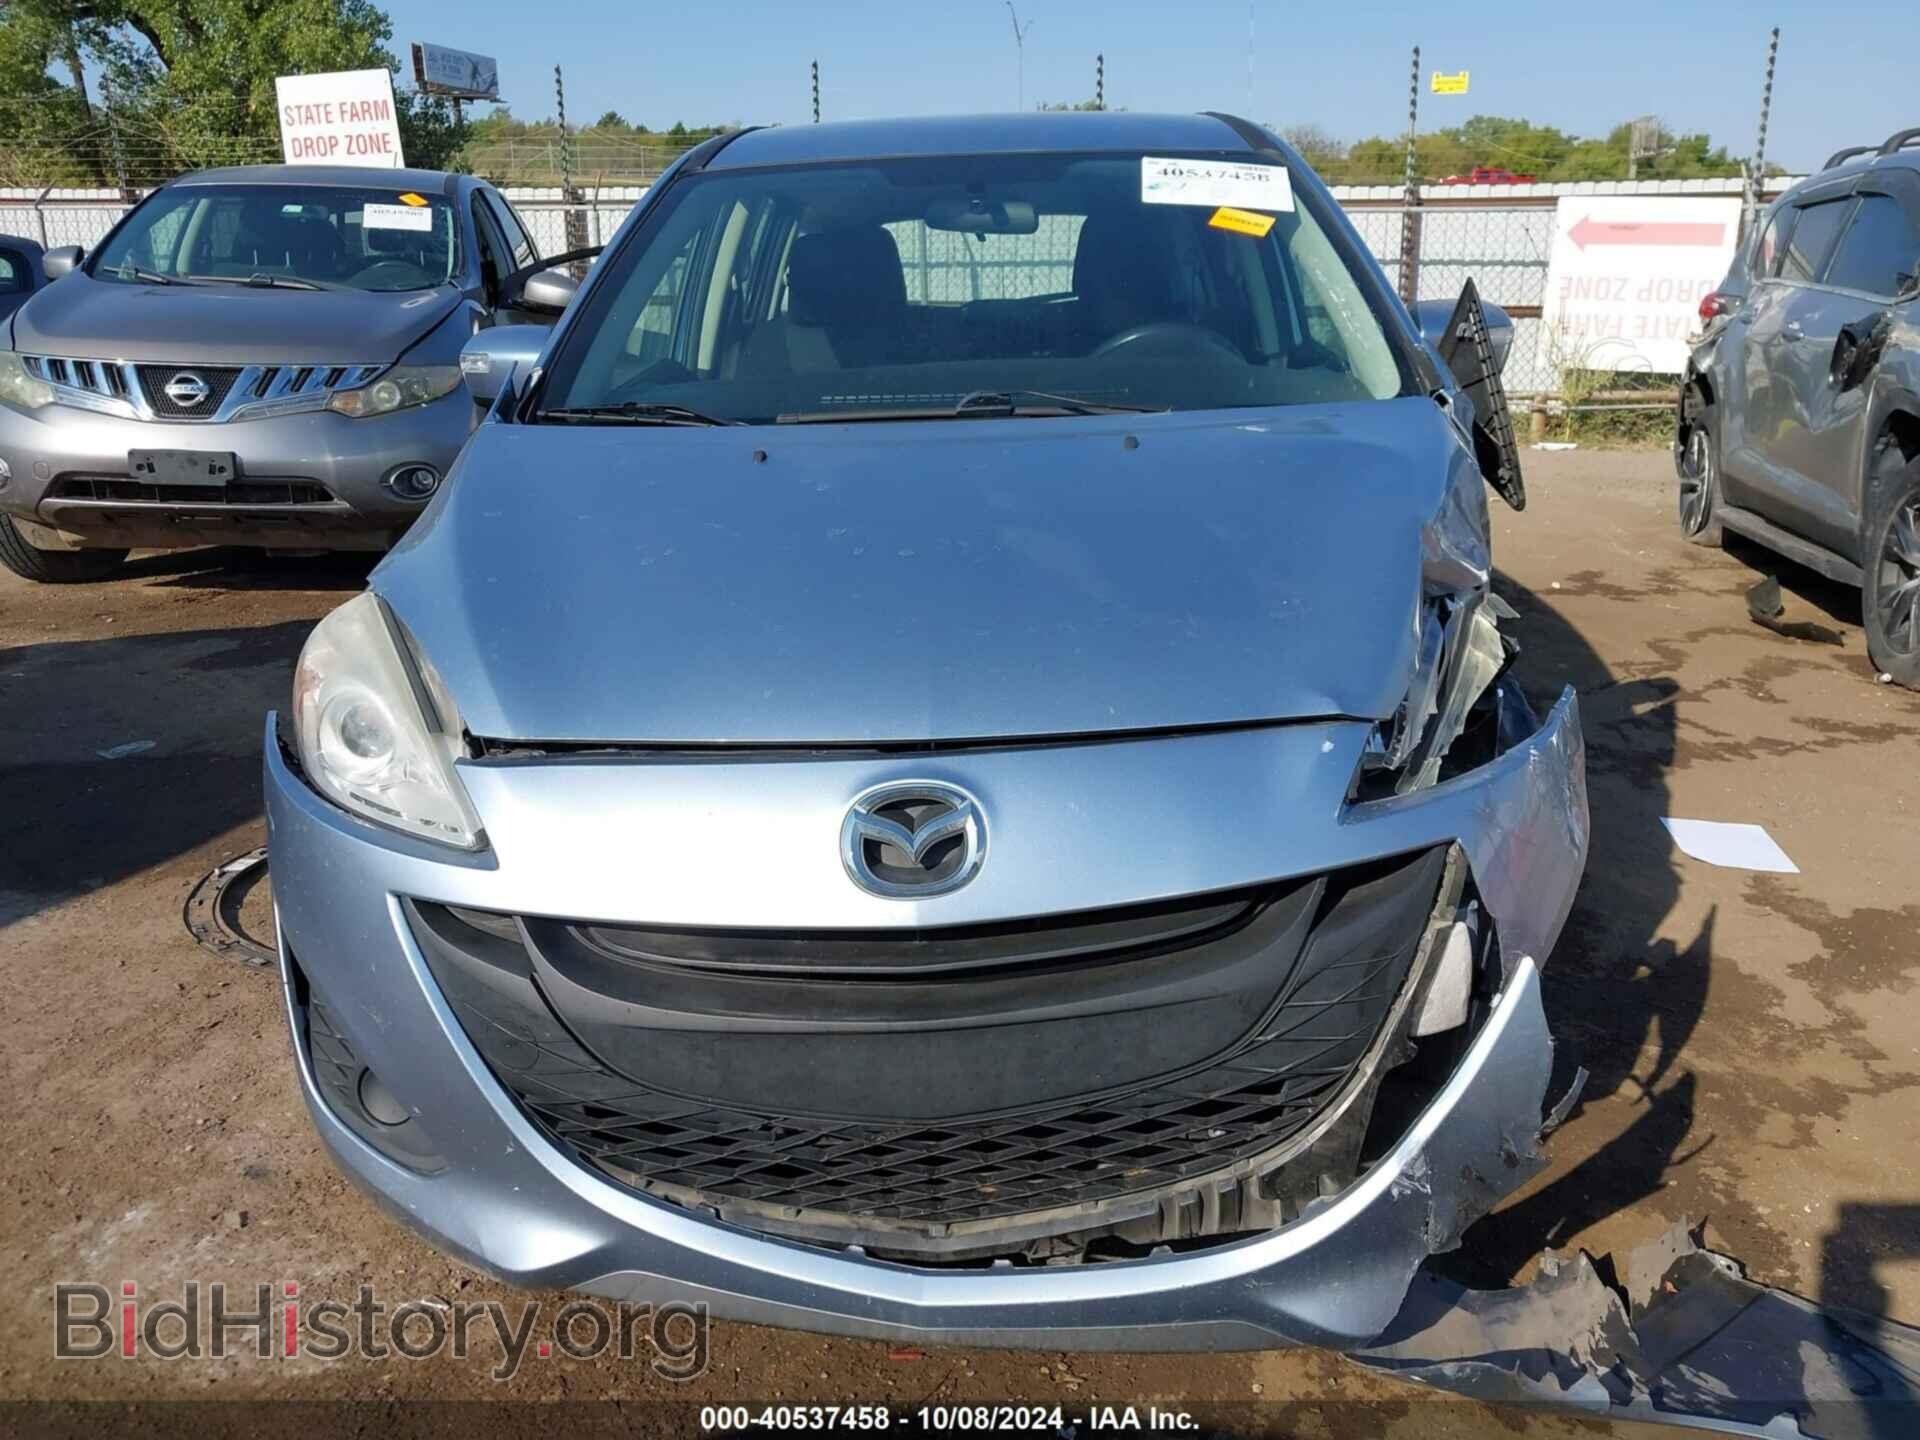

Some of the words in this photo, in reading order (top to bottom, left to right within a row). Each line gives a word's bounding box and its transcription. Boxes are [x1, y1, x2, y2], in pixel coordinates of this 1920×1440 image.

[284, 103, 334, 127] STATE
[339, 99, 390, 123] FARM
[291, 135, 339, 158] DROP
[344, 132, 392, 155] ZONE
[1559, 275, 1628, 301] ZONE
[1634, 315, 1695, 339] TATE
